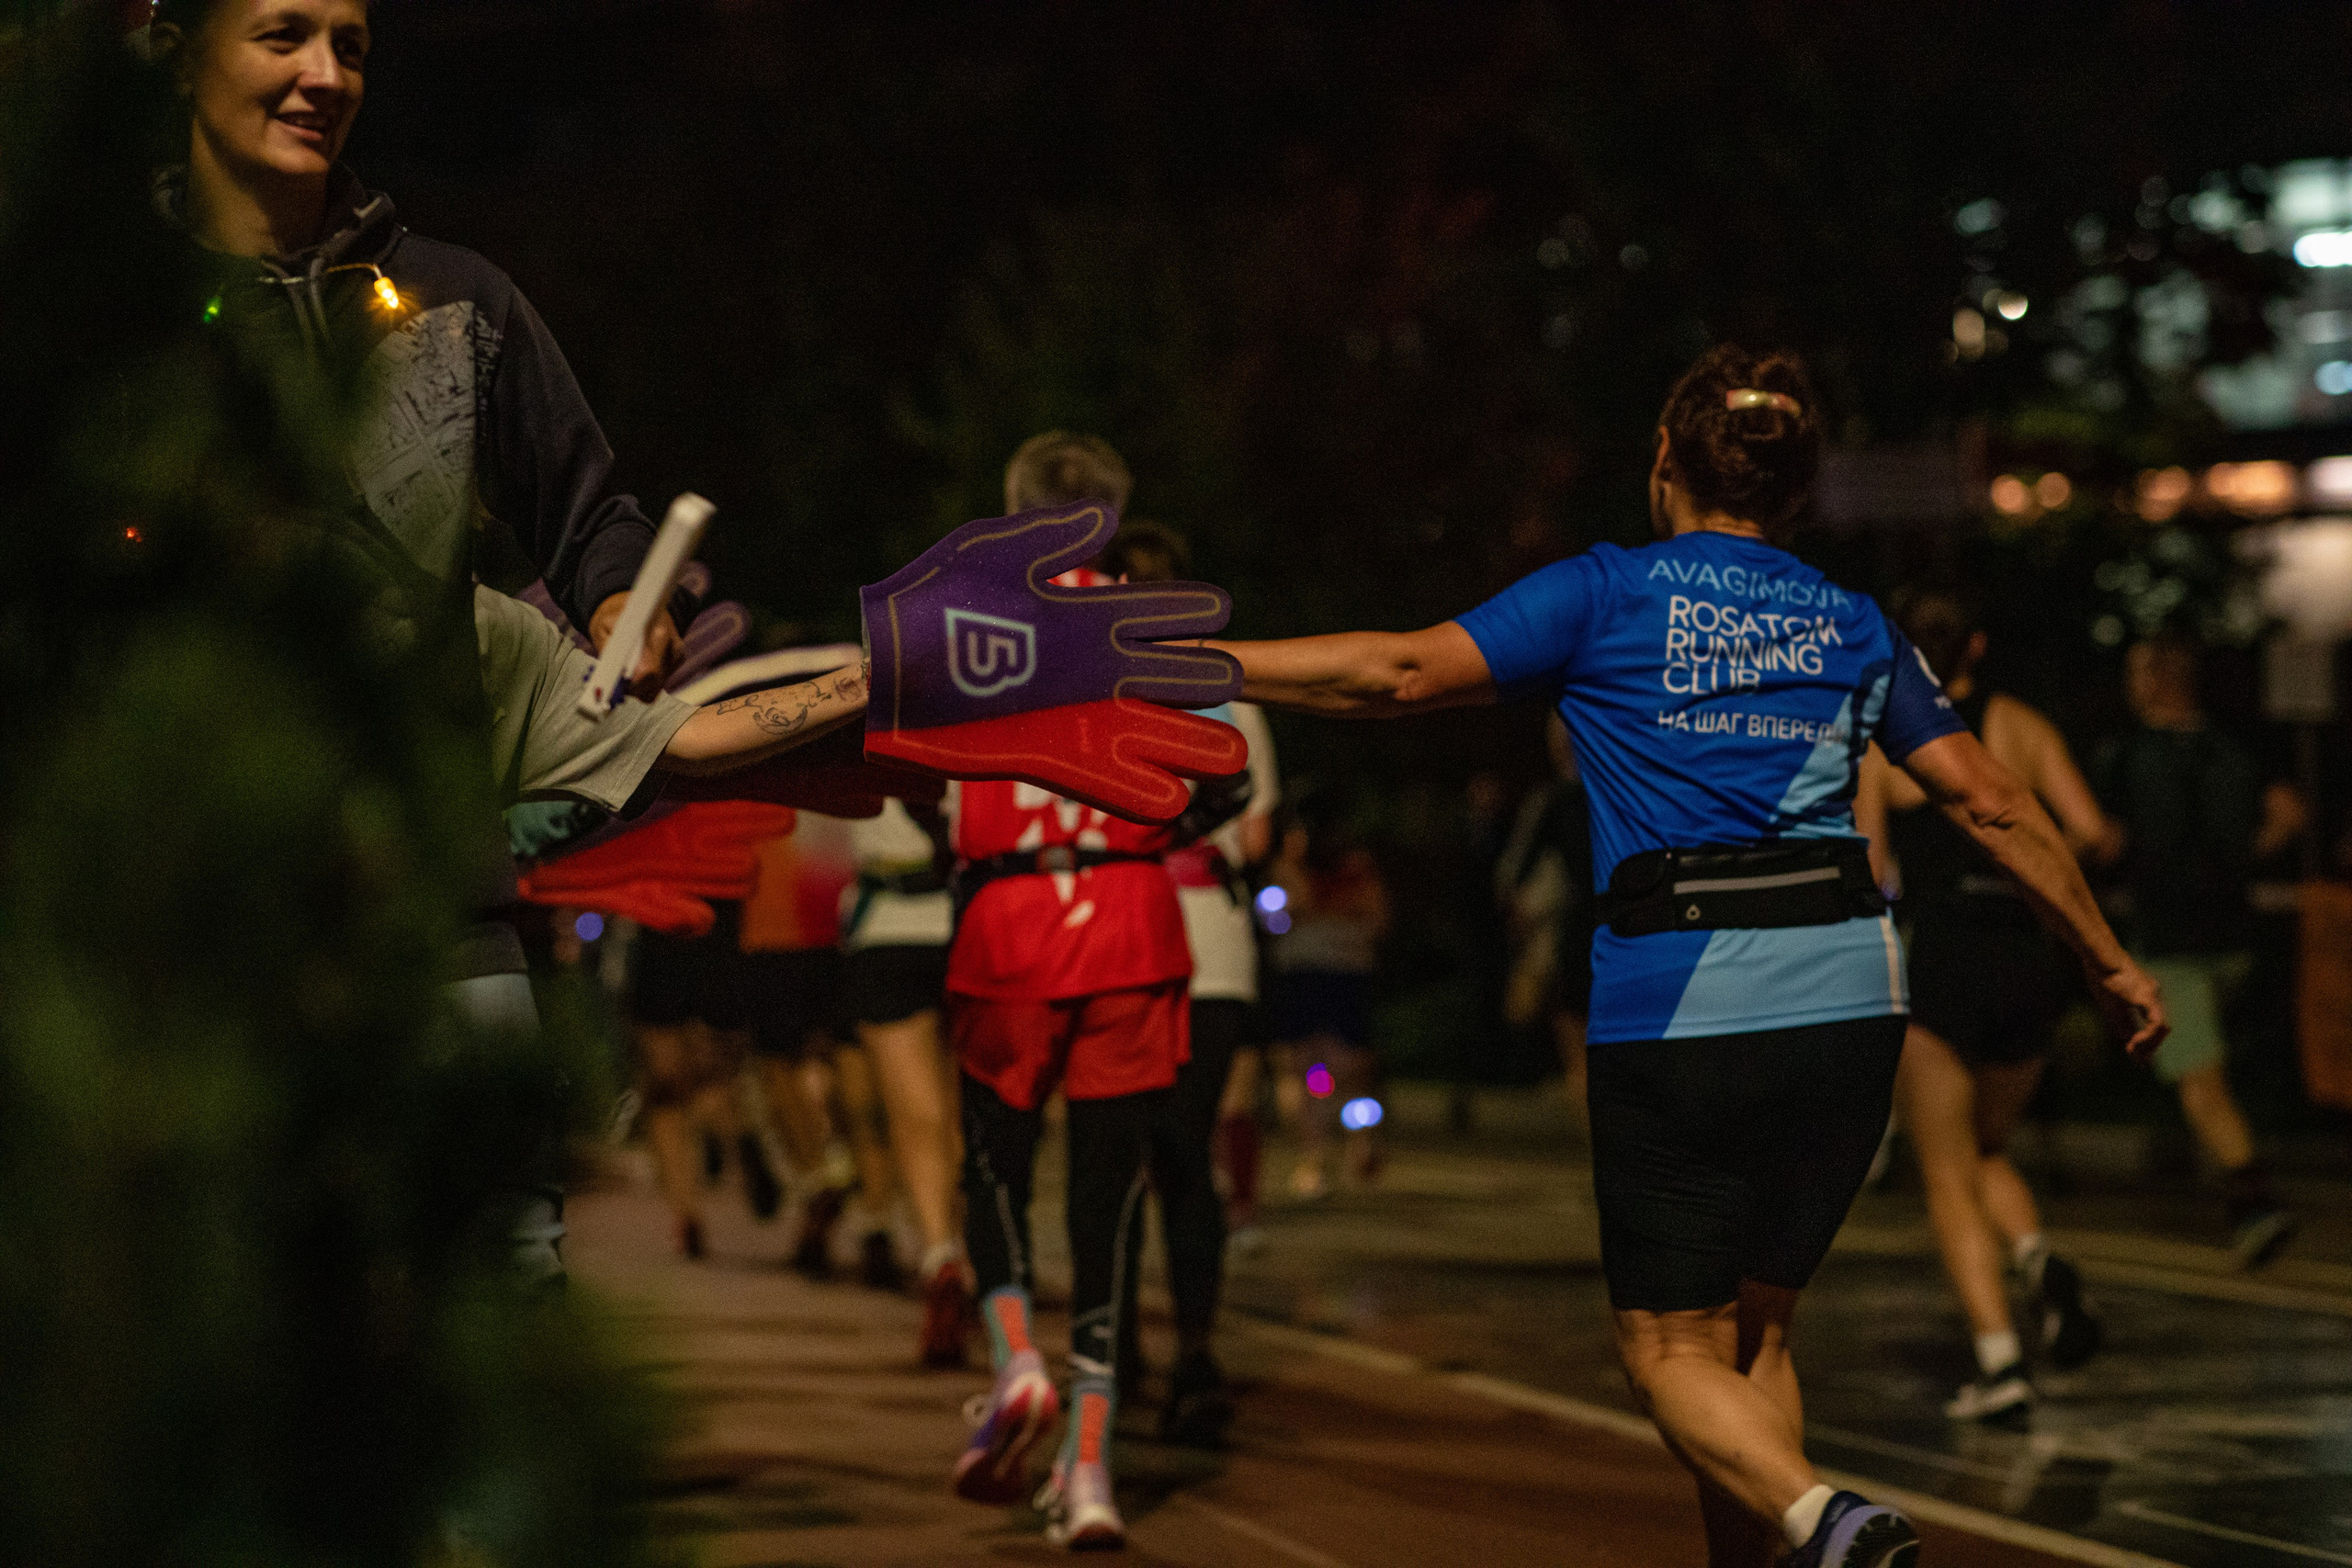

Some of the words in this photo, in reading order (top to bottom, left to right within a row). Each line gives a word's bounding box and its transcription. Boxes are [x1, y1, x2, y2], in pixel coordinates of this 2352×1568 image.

[1668, 593, 1843, 646] ROSATOM
[1665, 626, 1824, 676] RUNNING
[1661, 660, 1761, 695] CLUB
[1657, 710, 1690, 733] НА
[1693, 709, 1744, 735] ШАГ
